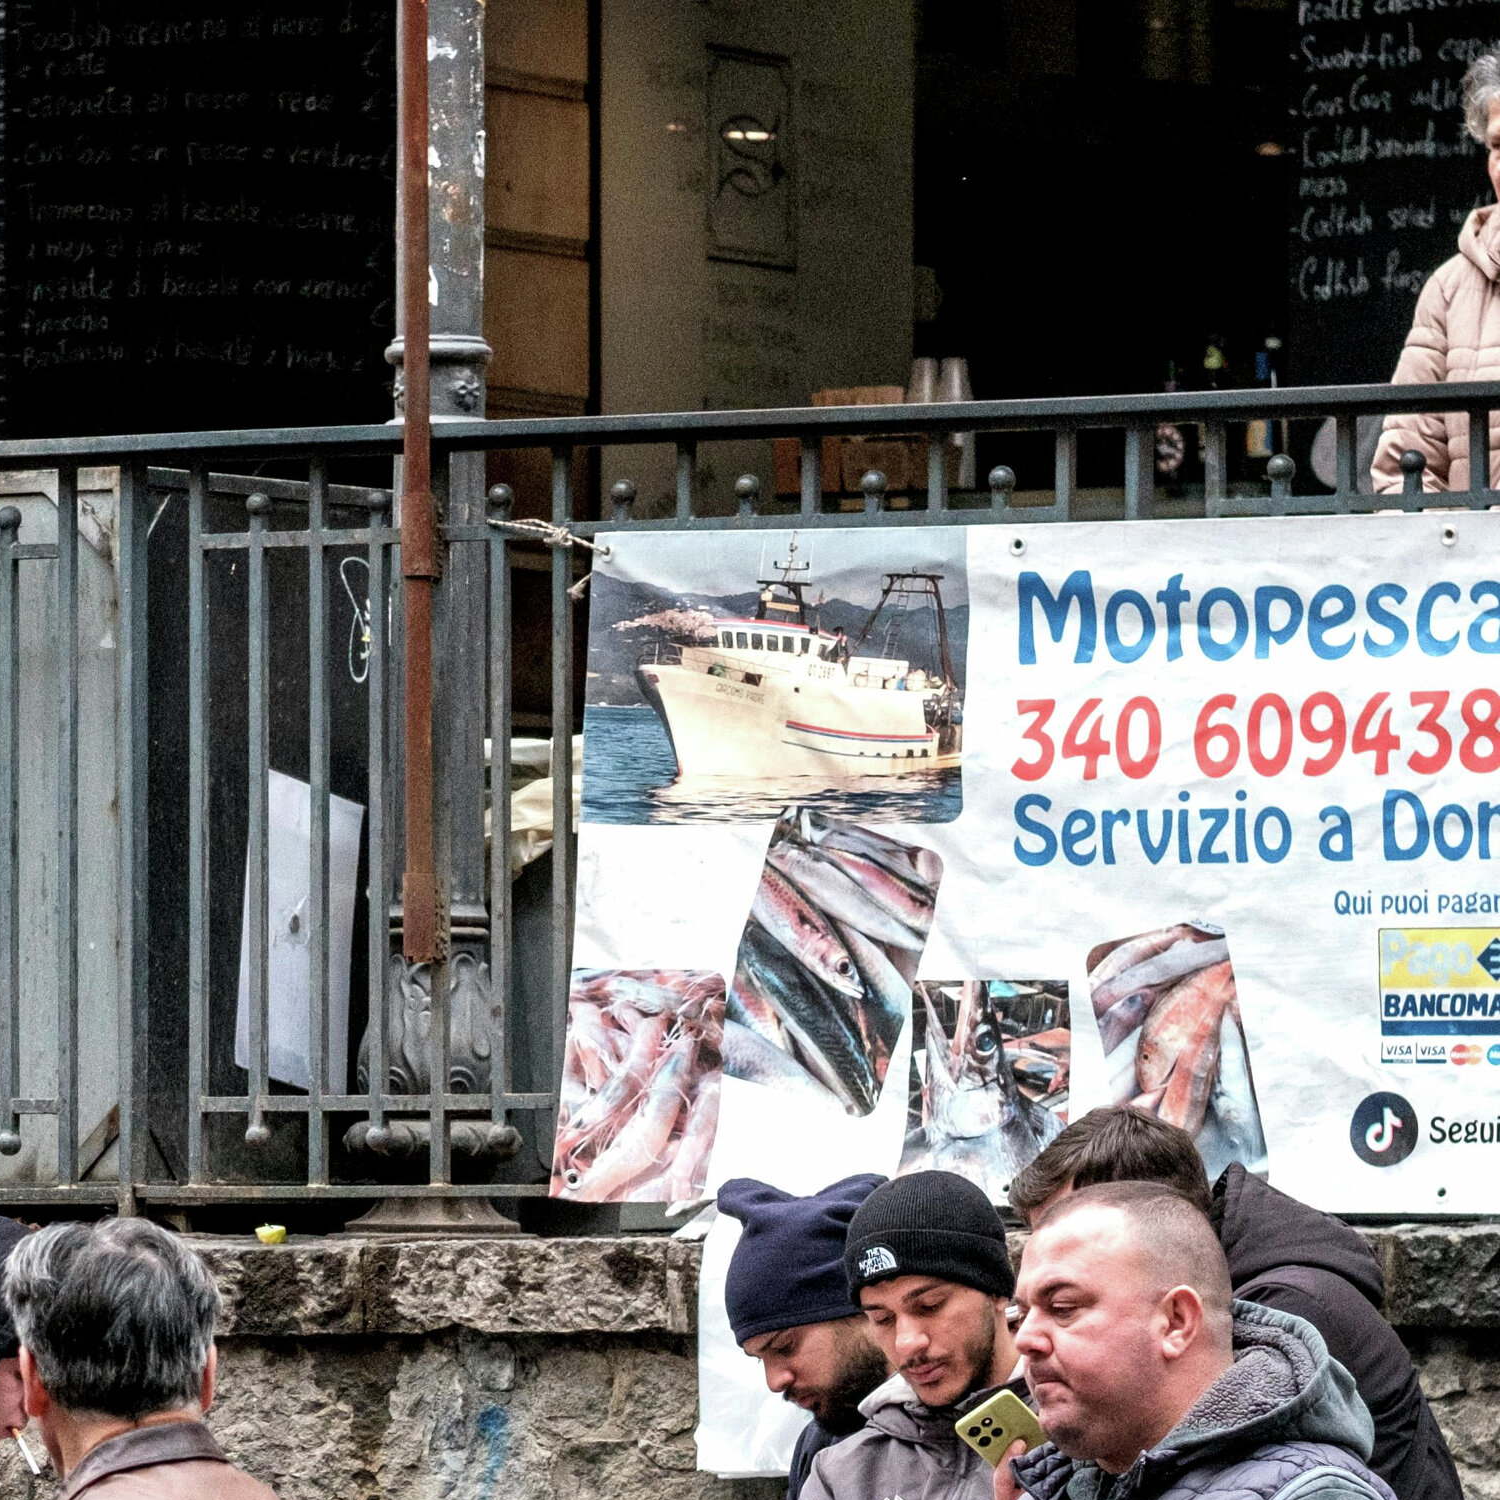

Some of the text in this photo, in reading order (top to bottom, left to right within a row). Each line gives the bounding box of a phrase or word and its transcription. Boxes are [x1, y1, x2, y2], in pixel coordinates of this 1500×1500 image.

[1018, 570, 1500, 665] Motopesca
[1011, 689, 1500, 780] 340 609438
[1013, 790, 1292, 867] Servizio
[1318, 806, 1353, 862] a
[1334, 890, 1372, 915] Qui
[1381, 889, 1428, 914] puoi
[1381, 929, 1474, 986] Pago
[1386, 1045, 1412, 1056] VISA
[1420, 1046, 1446, 1056] VISA
